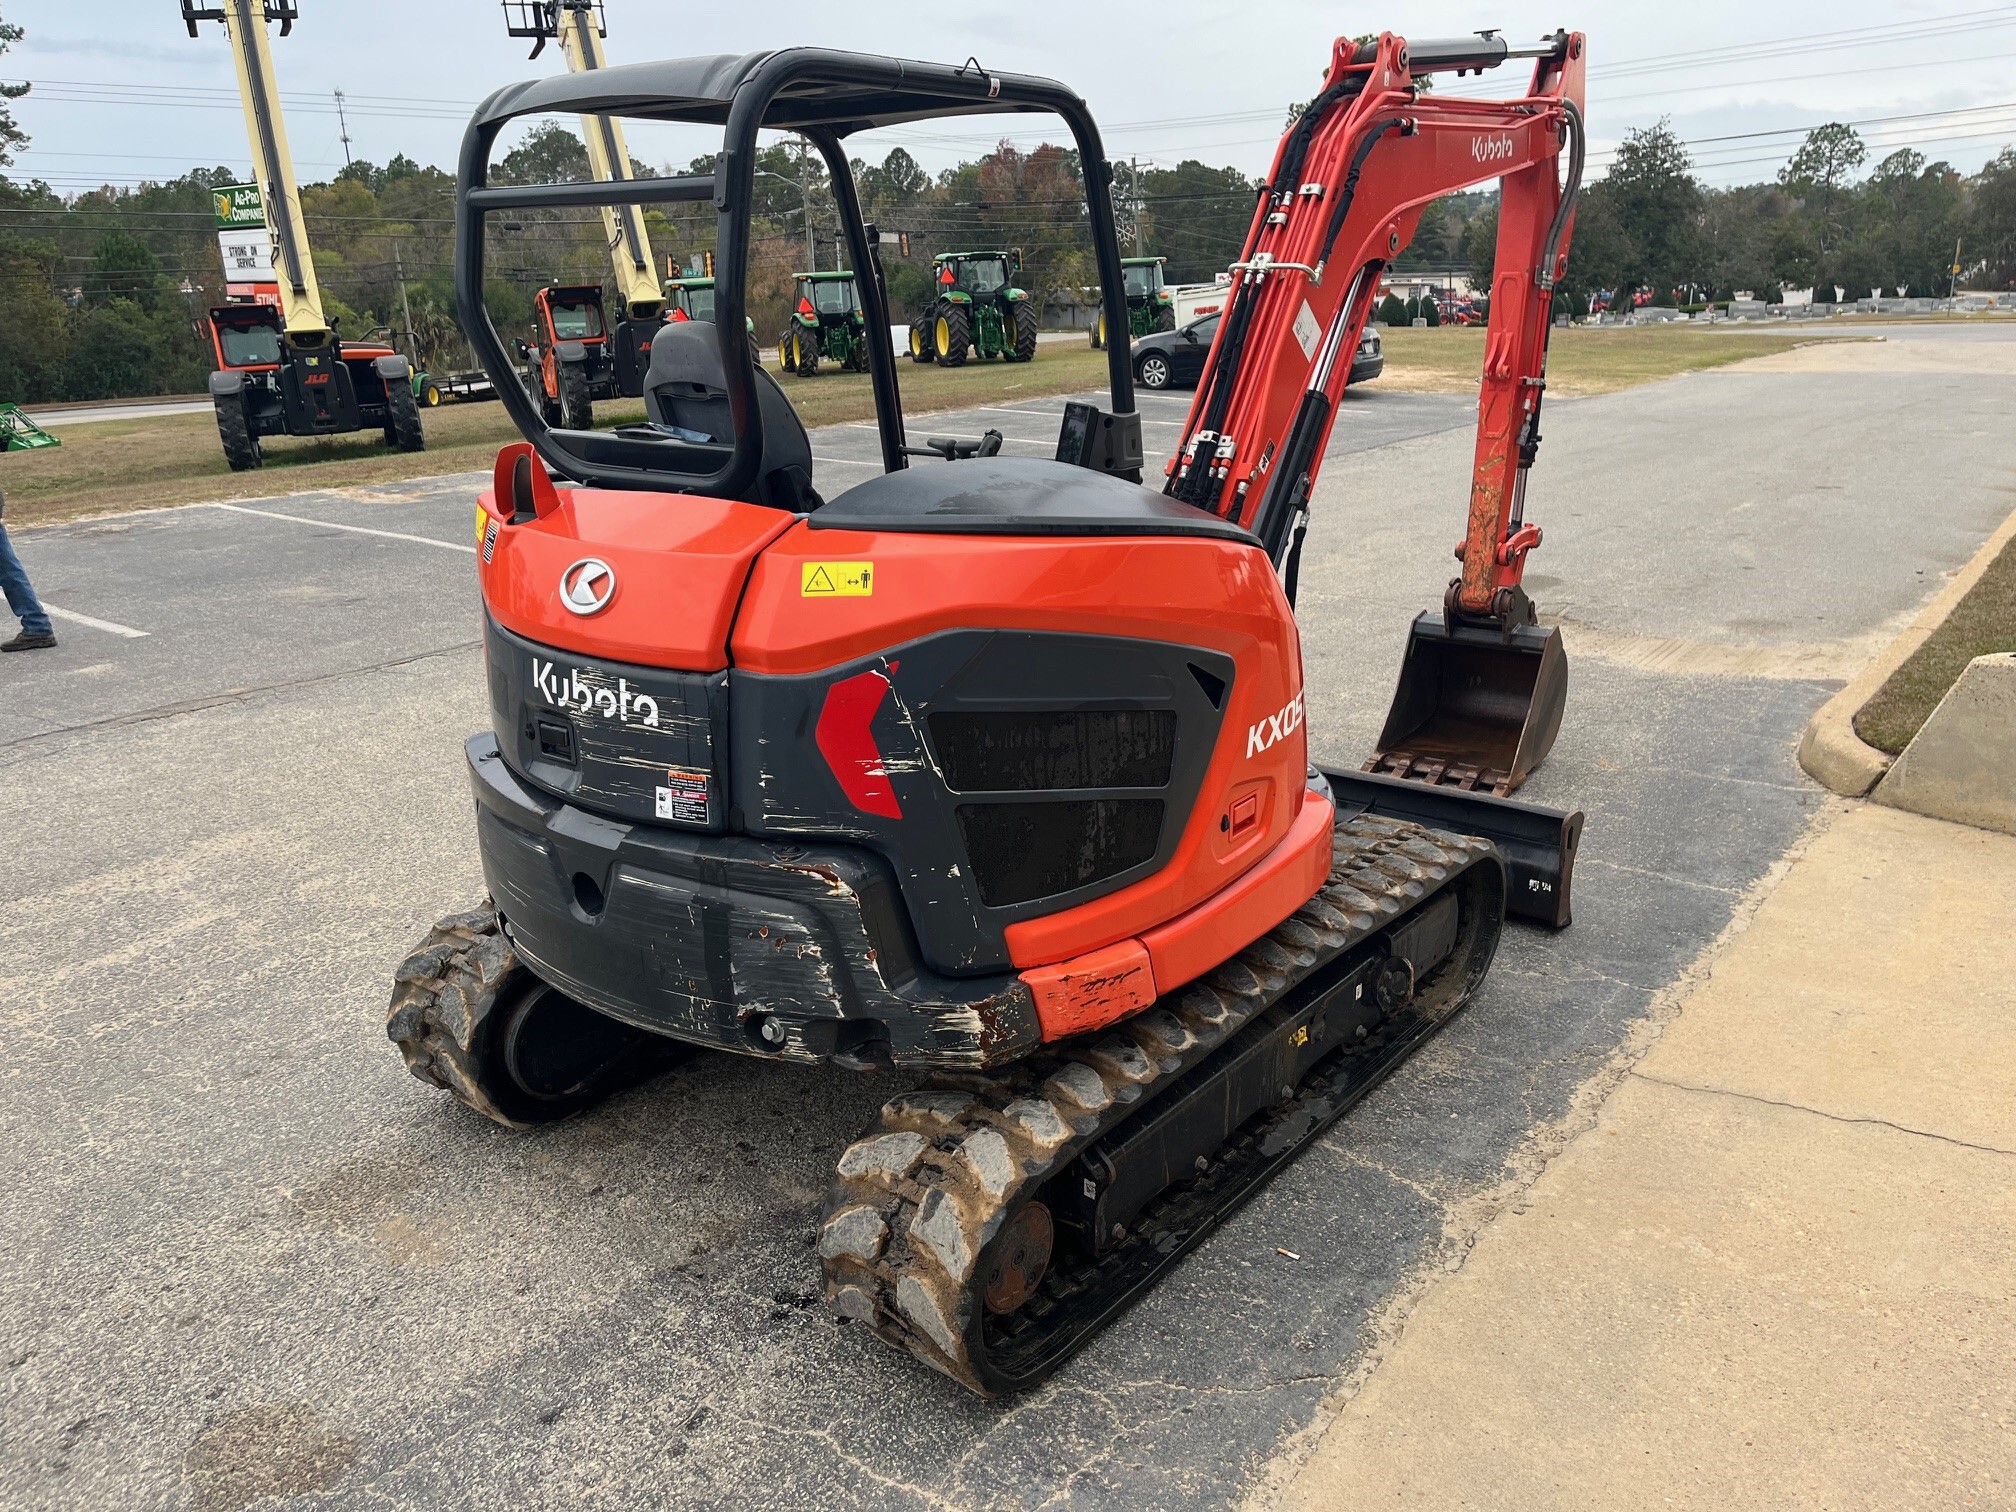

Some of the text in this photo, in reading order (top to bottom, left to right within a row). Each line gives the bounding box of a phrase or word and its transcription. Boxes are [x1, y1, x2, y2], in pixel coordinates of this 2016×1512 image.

[1471, 132, 1513, 163] Kubota
[231, 206, 265, 222] COMPANIE
[228, 245, 258, 257] STRONG ON
[236, 257, 257, 269] SERVICE
[256, 293, 282, 307] STIHL
[638, 341, 651, 351] JL
[304, 373, 330, 385] JLG
[532, 657, 660, 727] Kubota
[1246, 688, 1306, 760] KX05
